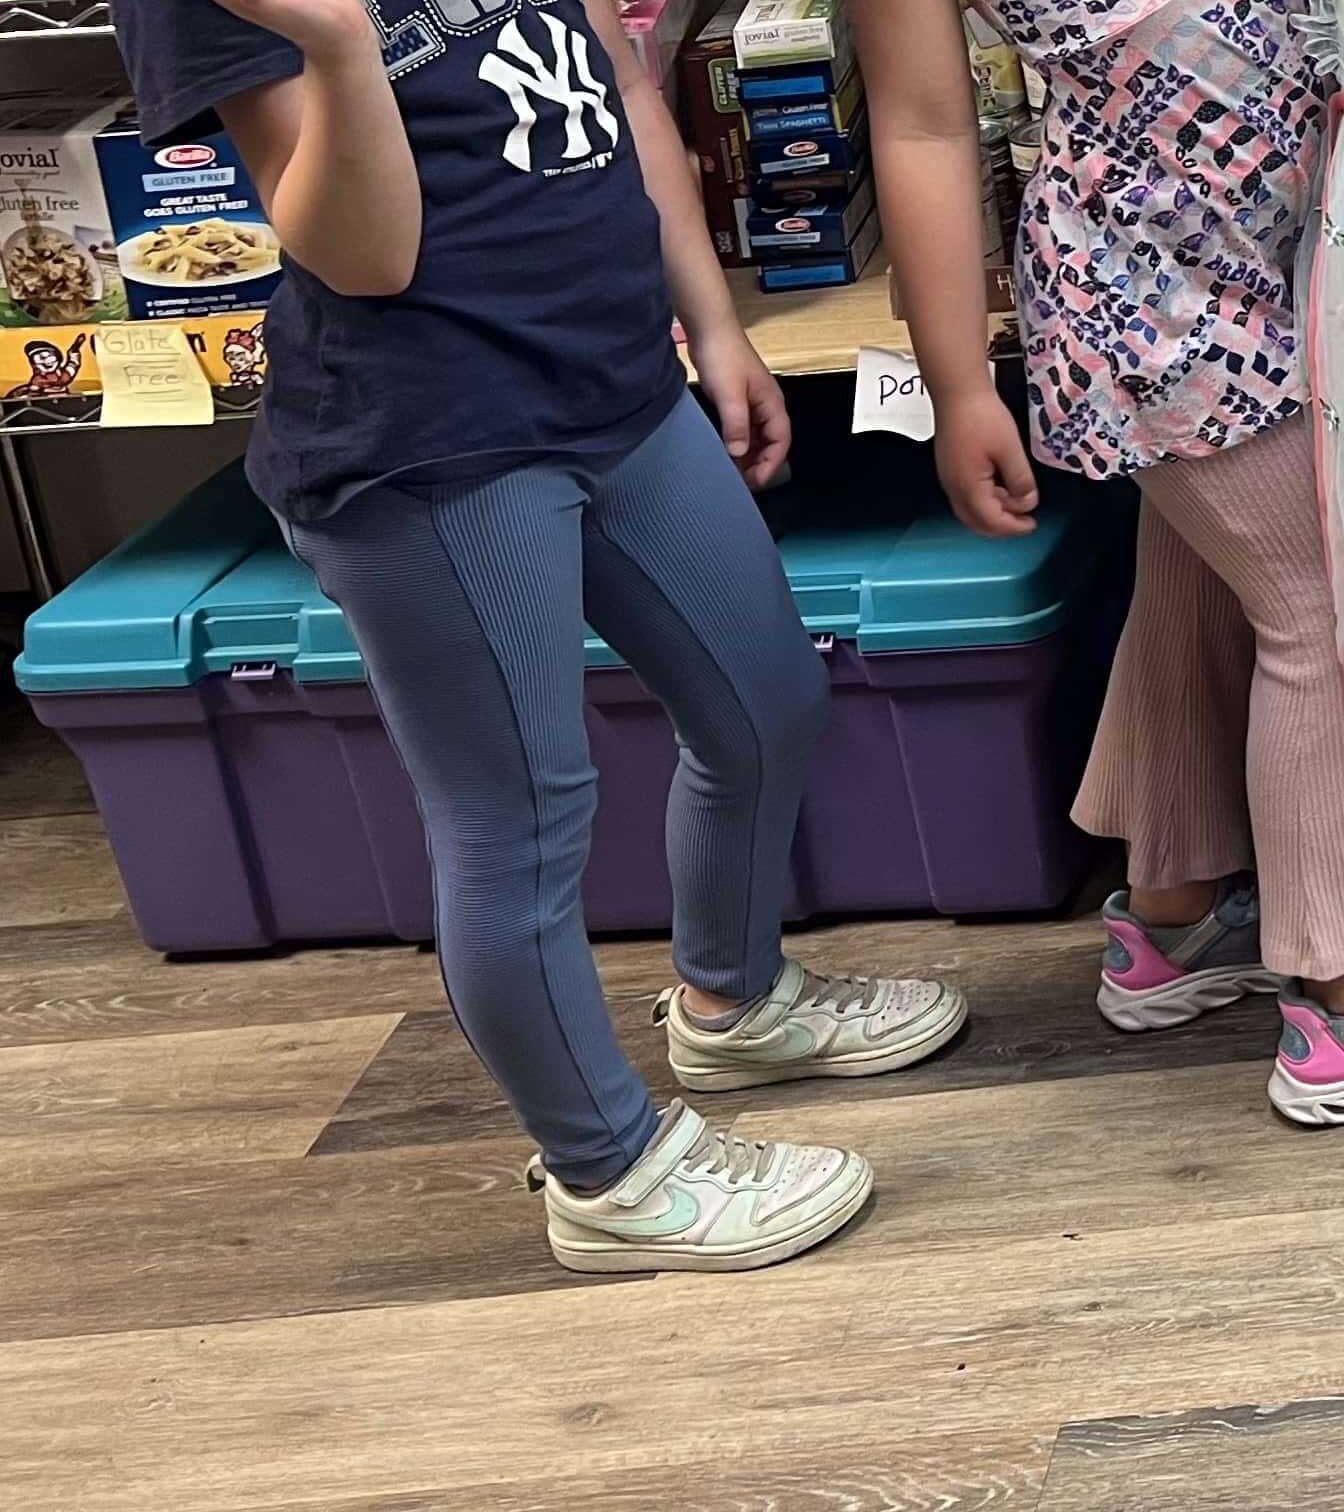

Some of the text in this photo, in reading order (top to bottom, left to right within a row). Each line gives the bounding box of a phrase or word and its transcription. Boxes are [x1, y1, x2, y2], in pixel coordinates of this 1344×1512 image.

[743, 26, 780, 44] jovial
[152, 172, 229, 188] GLUTEN FREE
[45, 197, 81, 212] free
[160, 193, 228, 207] GREAT TASTE
[144, 204, 217, 218] GOES GLUTEN
